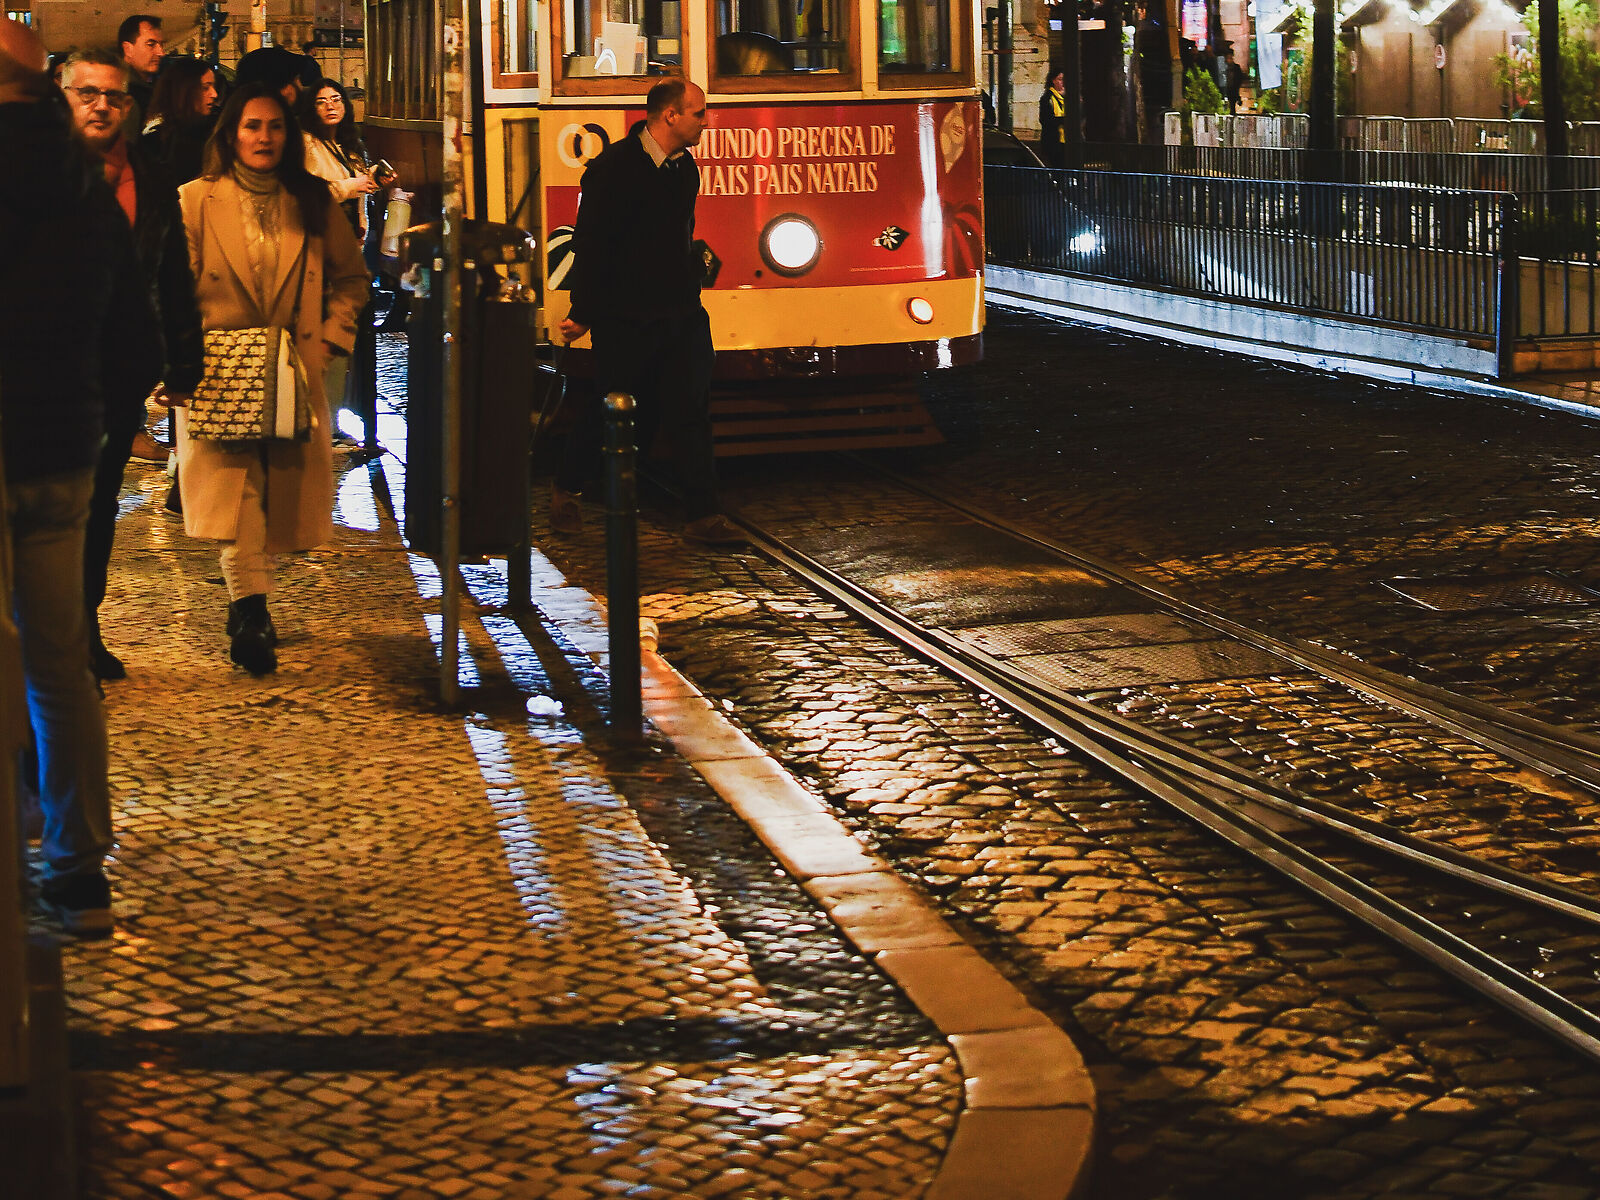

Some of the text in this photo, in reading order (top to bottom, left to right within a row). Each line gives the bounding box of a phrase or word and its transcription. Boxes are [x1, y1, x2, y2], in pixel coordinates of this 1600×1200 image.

[691, 124, 897, 160] MUNDO PRECISA DE
[753, 163, 804, 196] PAIS
[806, 161, 879, 194] NATAIS
